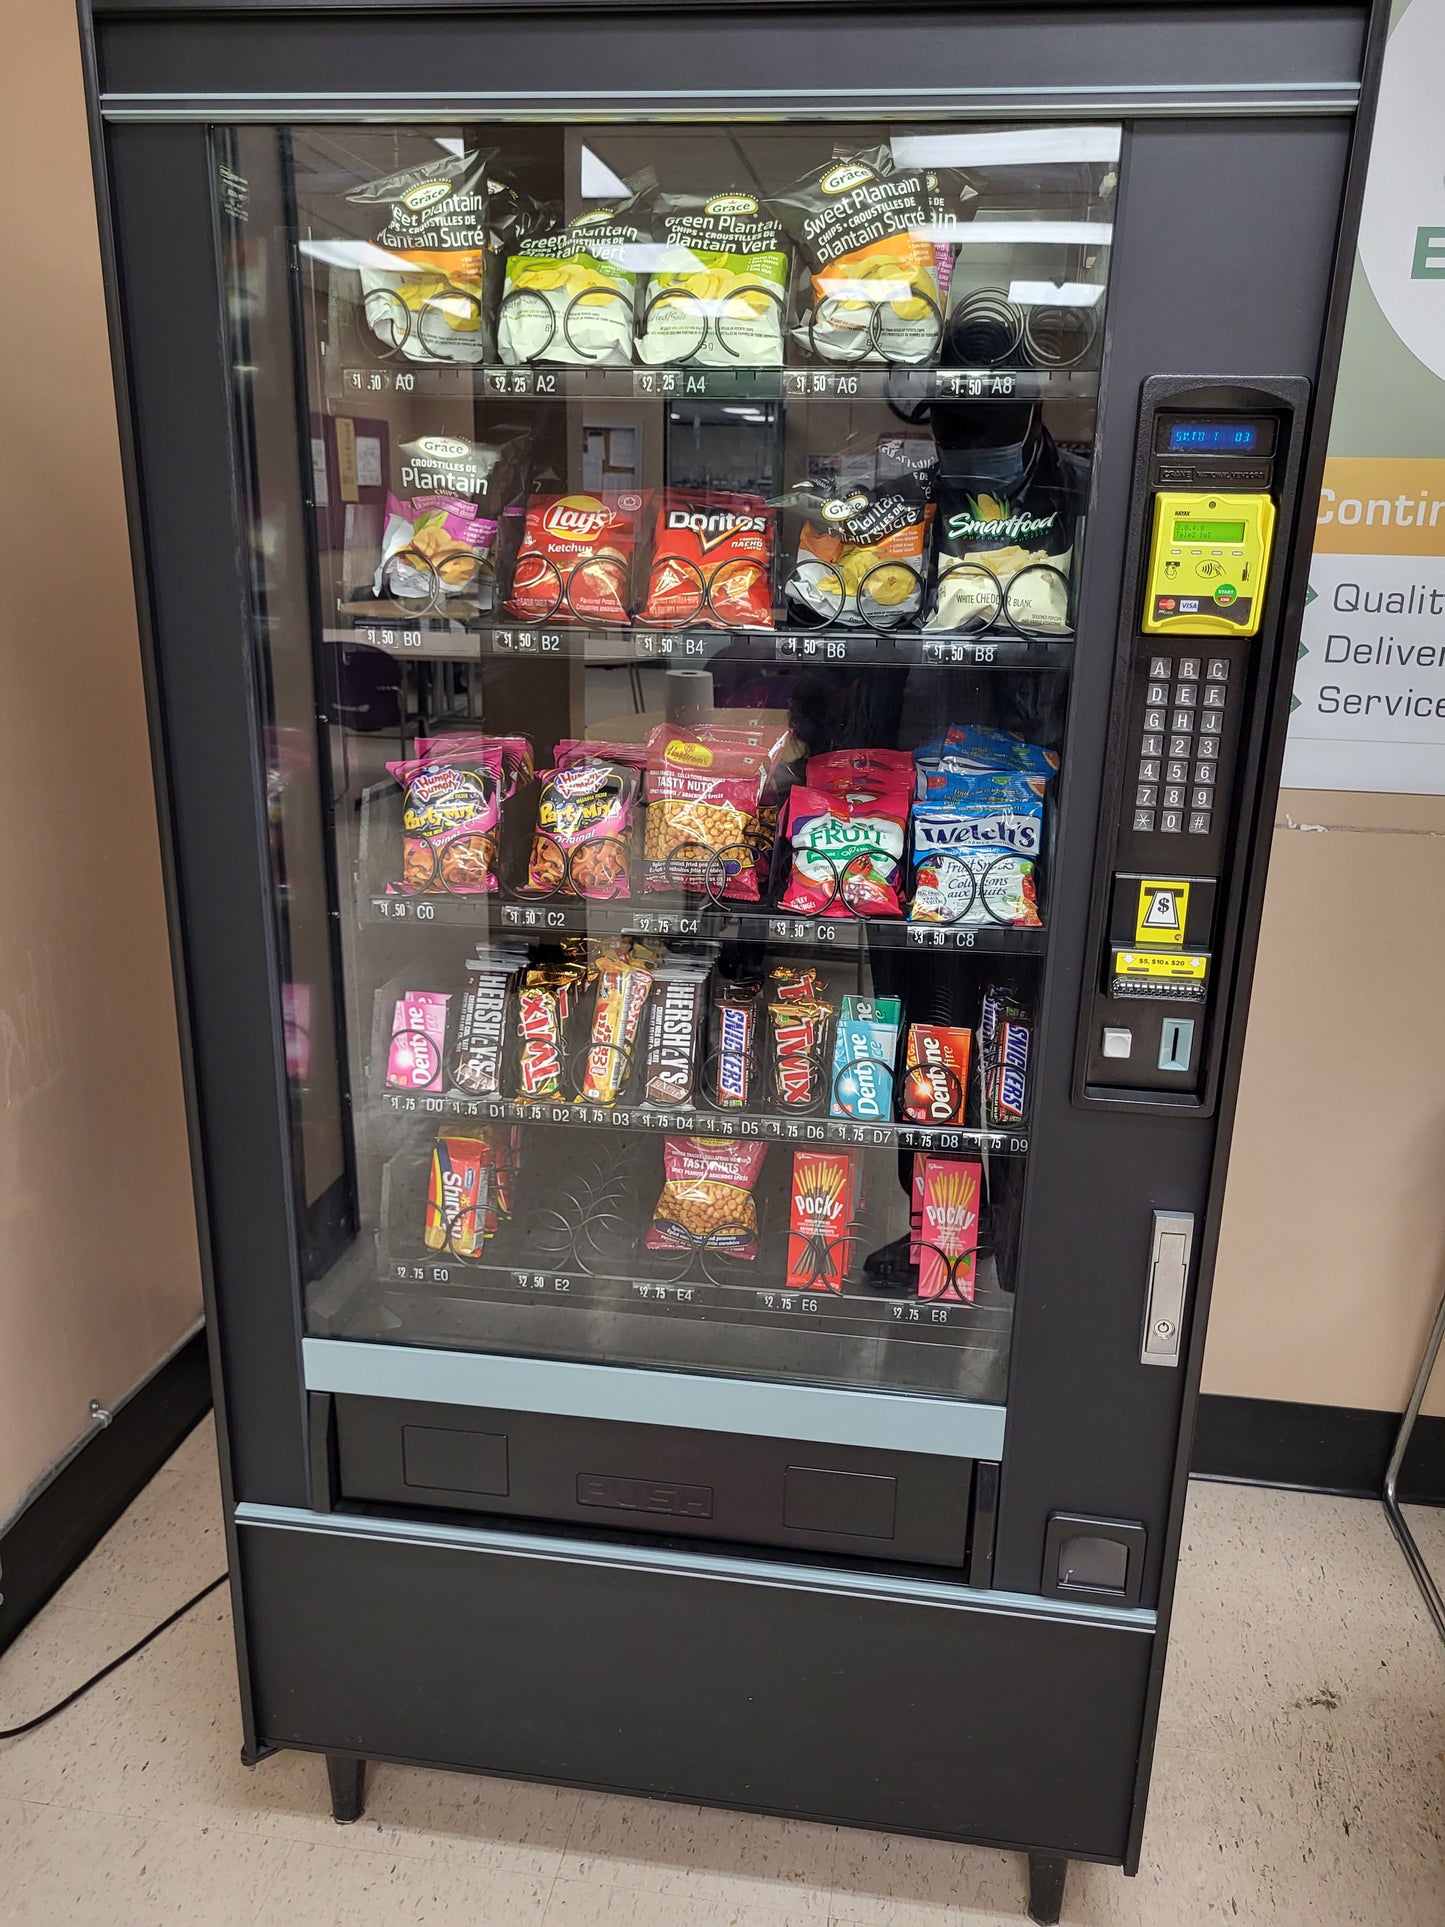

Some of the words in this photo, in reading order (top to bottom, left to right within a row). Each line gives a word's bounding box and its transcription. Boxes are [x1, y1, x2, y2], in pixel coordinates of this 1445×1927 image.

[830, 168, 869, 188] Grace
[410, 189, 444, 207] Grace
[422, 192, 482, 220] Plantain
[712, 203, 750, 212] Grace
[804, 197, 853, 240] Sweet
[852, 177, 921, 210] Plantain
[409, 216, 463, 234] CROUSTILLES
[465, 215, 476, 225] DE
[665, 216, 713, 229] Green
[818, 223, 843, 246] CHIPS
[849, 200, 904, 229] CROUSTILLES
[905, 197, 916, 207] DE
[441, 225, 484, 247] Sucré
[672, 225, 696, 236] CHIPS
[705, 231, 762, 242] CROUSTILLES
[816, 221, 884, 264] Plantain
[883, 206, 926, 233] Sucré
[520, 235, 566, 249] Green
[665, 232, 736, 253] Plantain
[742, 238, 778, 254] Vert
[592, 247, 626, 260] Vert
[395, 374, 414, 391] A0
[536, 375, 556, 393] A2
[686, 375, 706, 393] A4
[837, 377, 857, 394] A6
[992, 377, 1012, 394] A8
[424, 441, 464, 454] Grace
[411, 458, 464, 472] CROUSTILLES
[401, 467, 488, 495] Plantain
[548, 506, 609, 534] Lay's
[669, 511, 766, 532] Doritos
[948, 512, 1058, 538] Smartfood
[976, 592, 1012, 606] CHEDDR
[404, 632, 421, 647] B0
[542, 635, 560, 651] B2
[686, 639, 704, 655] B4
[788, 639, 815, 657] $1.50
[827, 643, 845, 659] B6
[934, 646, 963, 661] $1.50
[975, 646, 994, 662] B8
[1154, 661, 1165, 675] A
[1183, 663, 1194, 677] B
[1212, 663, 1223, 677] C
[1152, 687, 1162, 702] D
[1181, 688, 1191, 702] E
[1209, 689, 1219, 703] F
[1149, 713, 1159, 727] G
[1177, 714, 1188, 728] H
[1206, 715, 1216, 729] J
[1148, 739, 1155, 752] 1
[1174, 740, 1185, 753] 2
[1203, 741, 1213, 754] 3
[1144, 764, 1152, 777] 4
[1172, 765, 1181, 778] 5
[1200, 766, 1210, 779] 6
[657, 777, 684, 789] TASTY
[687, 780, 713, 792] NUTS
[1142, 789, 1151, 802] 7
[1169, 790, 1179, 803] 8
[1197, 791, 1207, 805] 9
[404, 807, 440, 830] Party
[540, 802, 582, 825] Party
[1166, 815, 1176, 828] 0
[1194, 816, 1204, 829] #
[921, 821, 1035, 848] Welch's
[948, 890, 970, 898] aux
[417, 905, 434, 919] C0
[548, 912, 565, 926] C2
[680, 918, 697, 934] C4
[817, 925, 835, 940] C6
[914, 931, 944, 945] $3.50
[957, 932, 974, 946] C8
[660, 986, 695, 1085] HERSHEY'S
[520, 995, 561, 1093] TWIX
[721, 1008, 746, 1097] SNICKERS
[774, 1018, 814, 1103] TWIX
[851, 1033, 879, 1116] Dentyne
[1003, 1024, 1029, 1115] SNICKERS
[923, 1037, 953, 1119] Dentyne
[426, 1099, 443, 1112] D0
[490, 1104, 506, 1118] D1
[552, 1109, 569, 1122] D2
[613, 1112, 630, 1126] D3
[676, 1117, 693, 1130] D4
[741, 1121, 758, 1136] D5
[807, 1124, 825, 1139] D6
[873, 1128, 891, 1144] D7
[940, 1133, 959, 1149] D8
[1010, 1137, 1028, 1152] D9
[433, 1268, 449, 1281] E0
[555, 1278, 570, 1291] E2
[677, 1288, 692, 1301] E4
[802, 1300, 818, 1312] E6
[931, 1310, 947, 1322] E8
